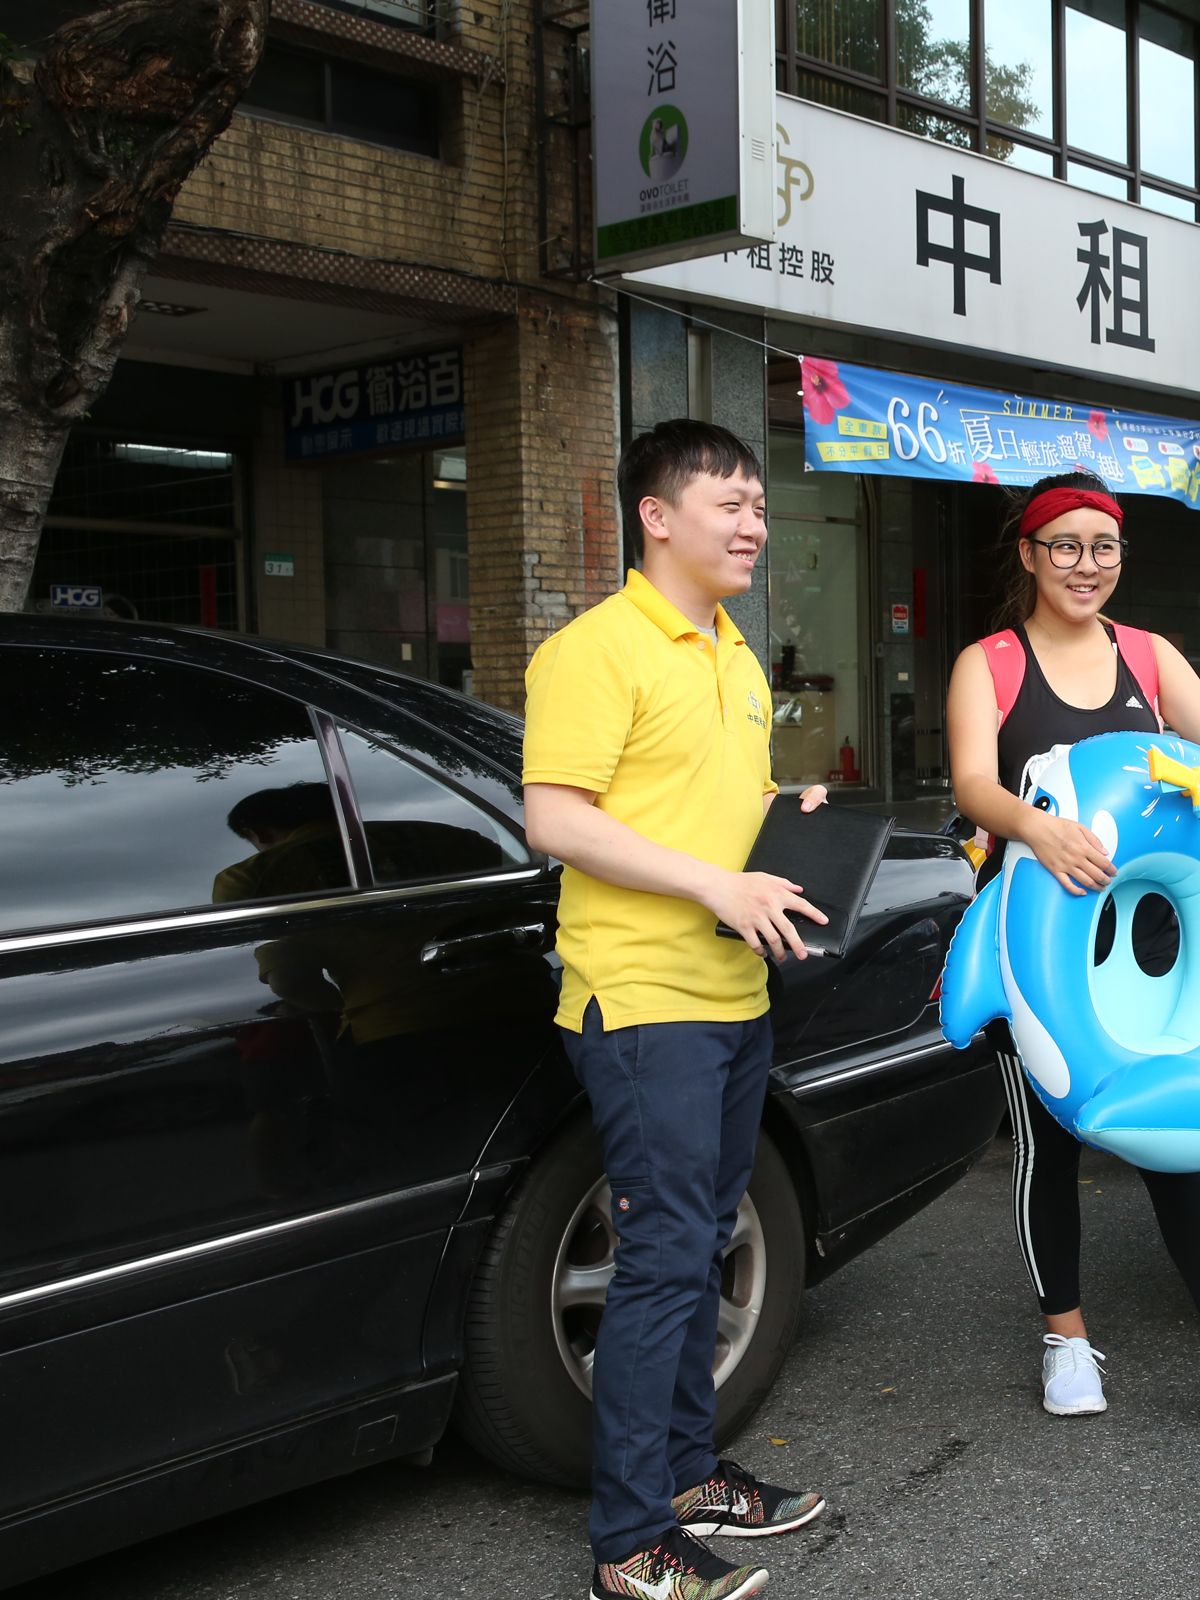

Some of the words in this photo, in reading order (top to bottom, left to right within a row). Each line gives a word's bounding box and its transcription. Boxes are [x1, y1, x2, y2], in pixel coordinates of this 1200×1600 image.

[723, 242, 834, 285] 租控股
[291, 369, 360, 428] HCG
[1003, 400, 1074, 420] SUMMER
[53, 587, 100, 606] HCG
